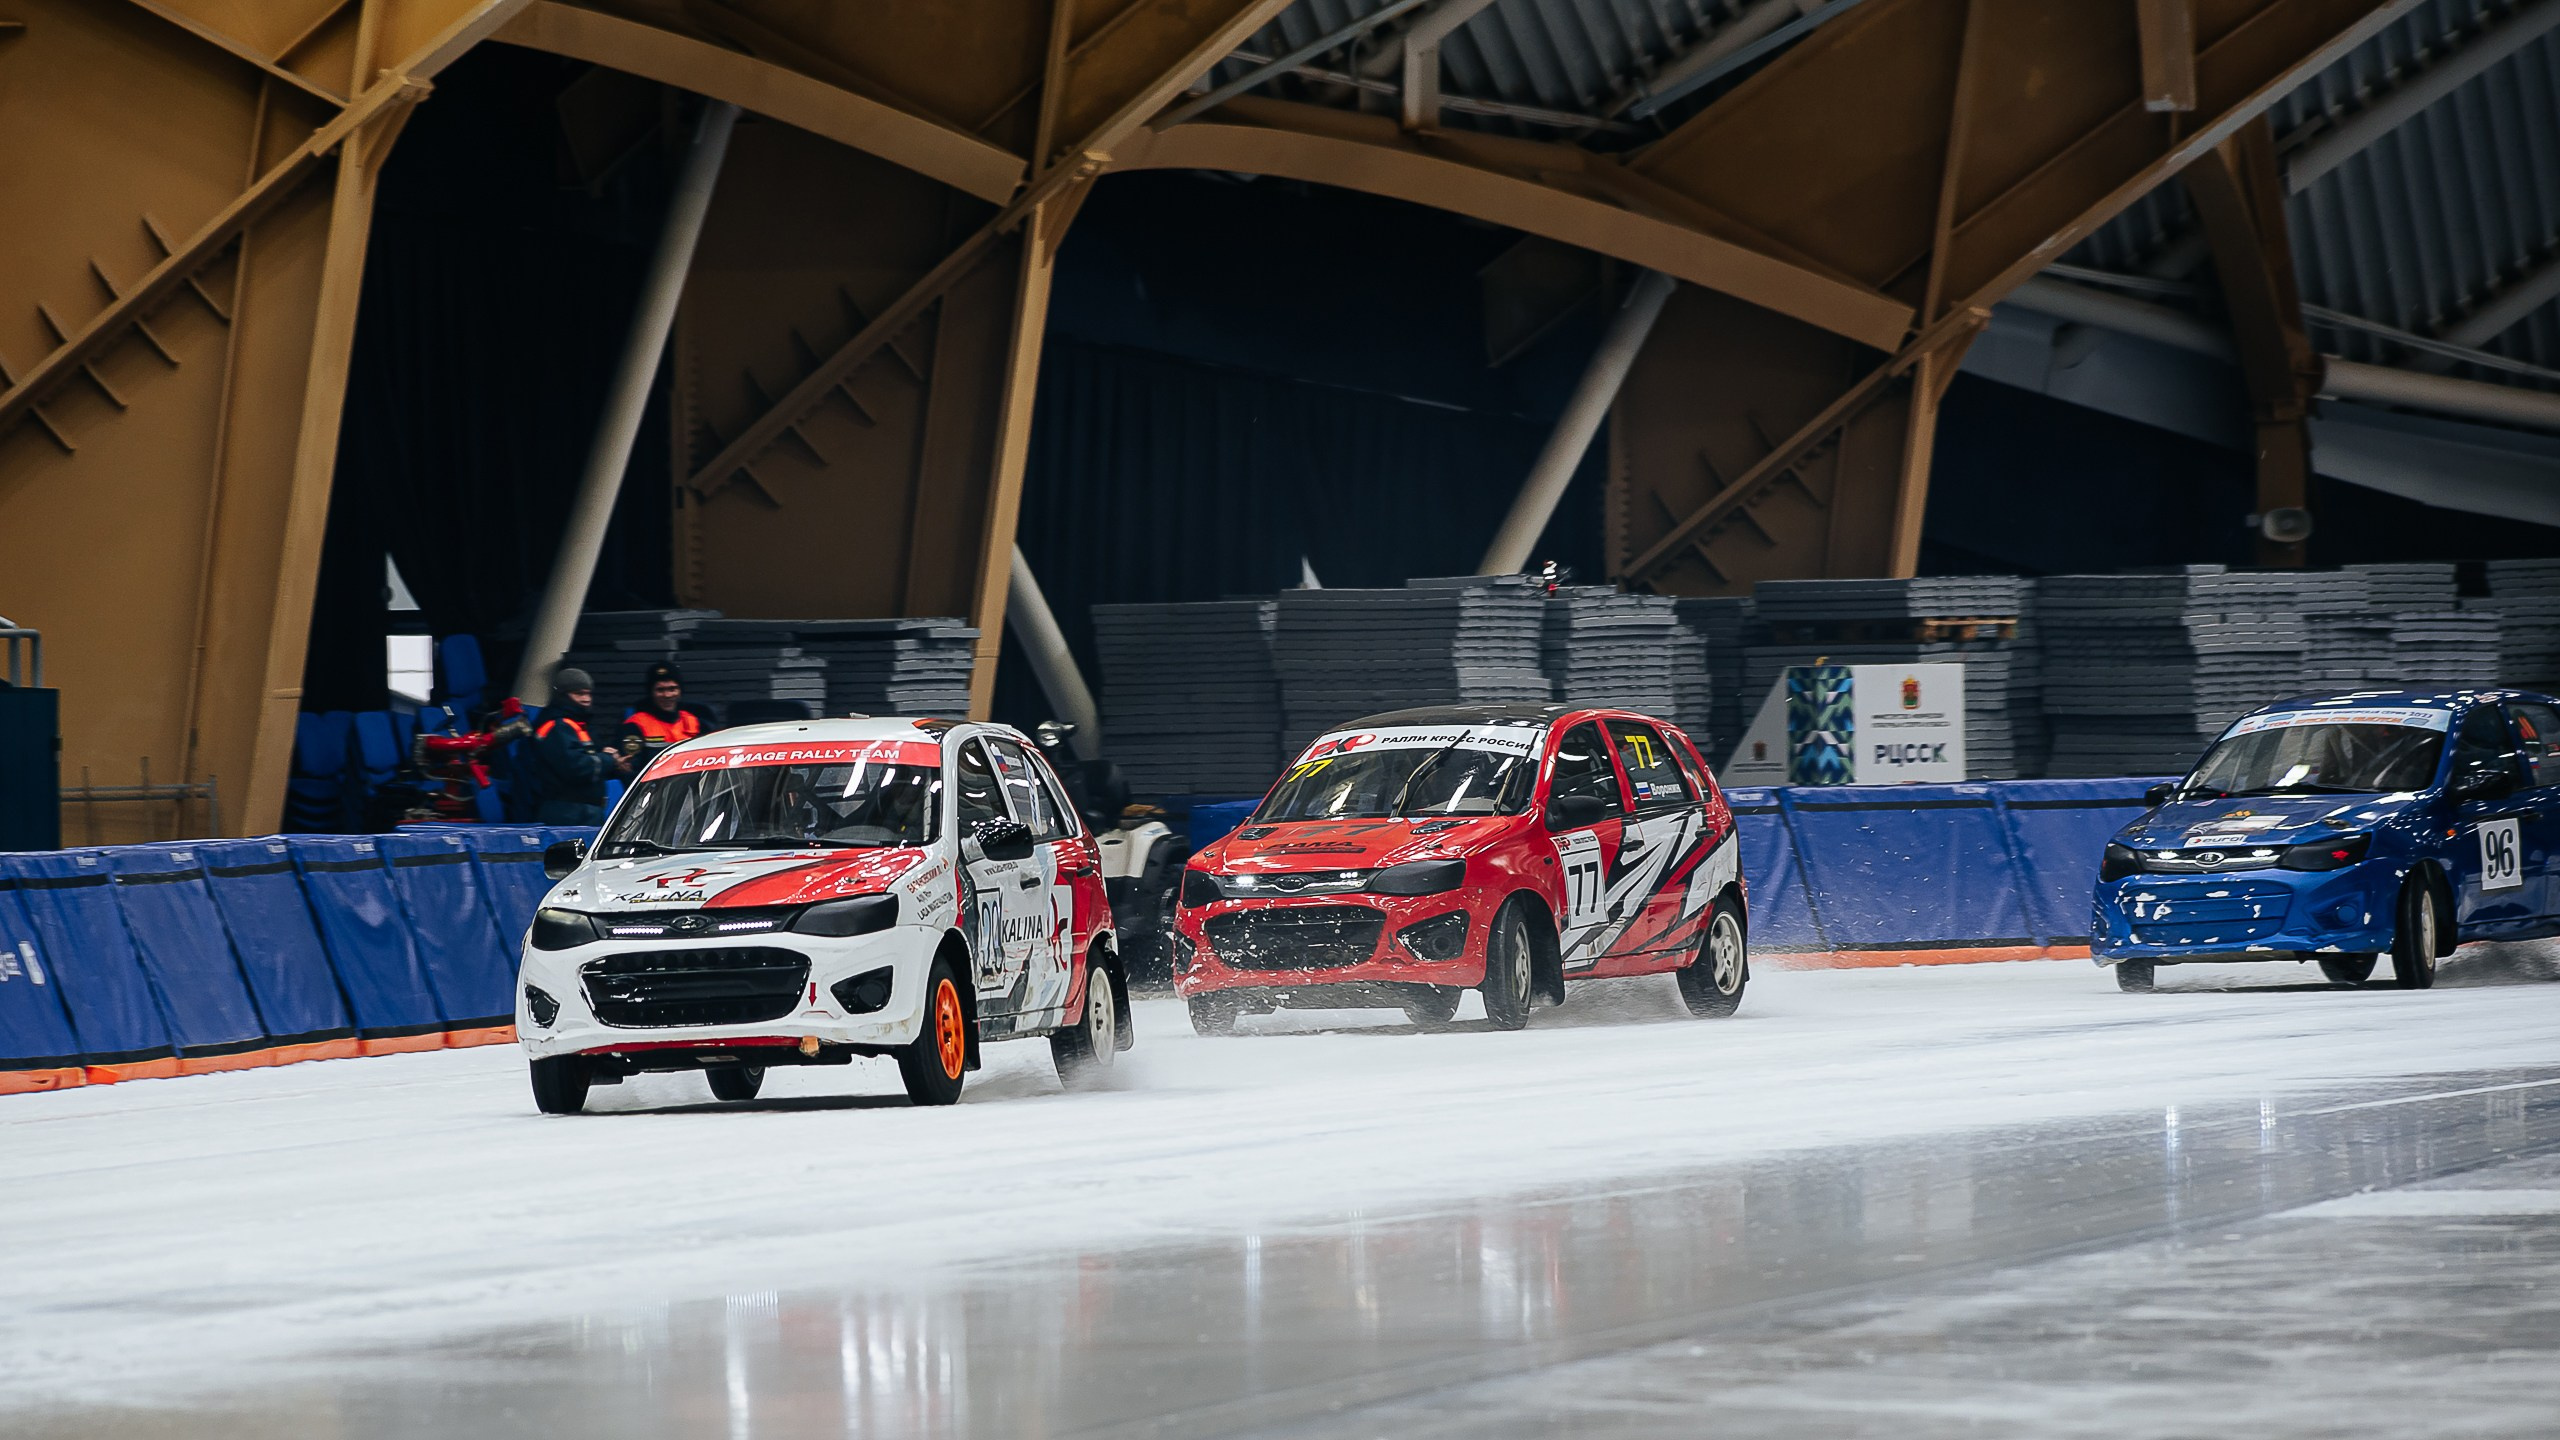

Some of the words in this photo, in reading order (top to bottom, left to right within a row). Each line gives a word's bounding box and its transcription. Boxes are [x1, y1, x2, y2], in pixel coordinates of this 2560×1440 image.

[1381, 735, 1427, 745] РАЛЛИ
[1624, 735, 1656, 769] 77
[682, 755, 726, 769] LADA
[790, 749, 847, 764] RALLY
[849, 748, 901, 760] TEAM
[1873, 743, 1949, 767] РЦССК
[1288, 758, 1335, 783] 77
[2485, 828, 2514, 880] 96
[1568, 860, 1599, 917] 77
[1002, 914, 1044, 944] KALINA
